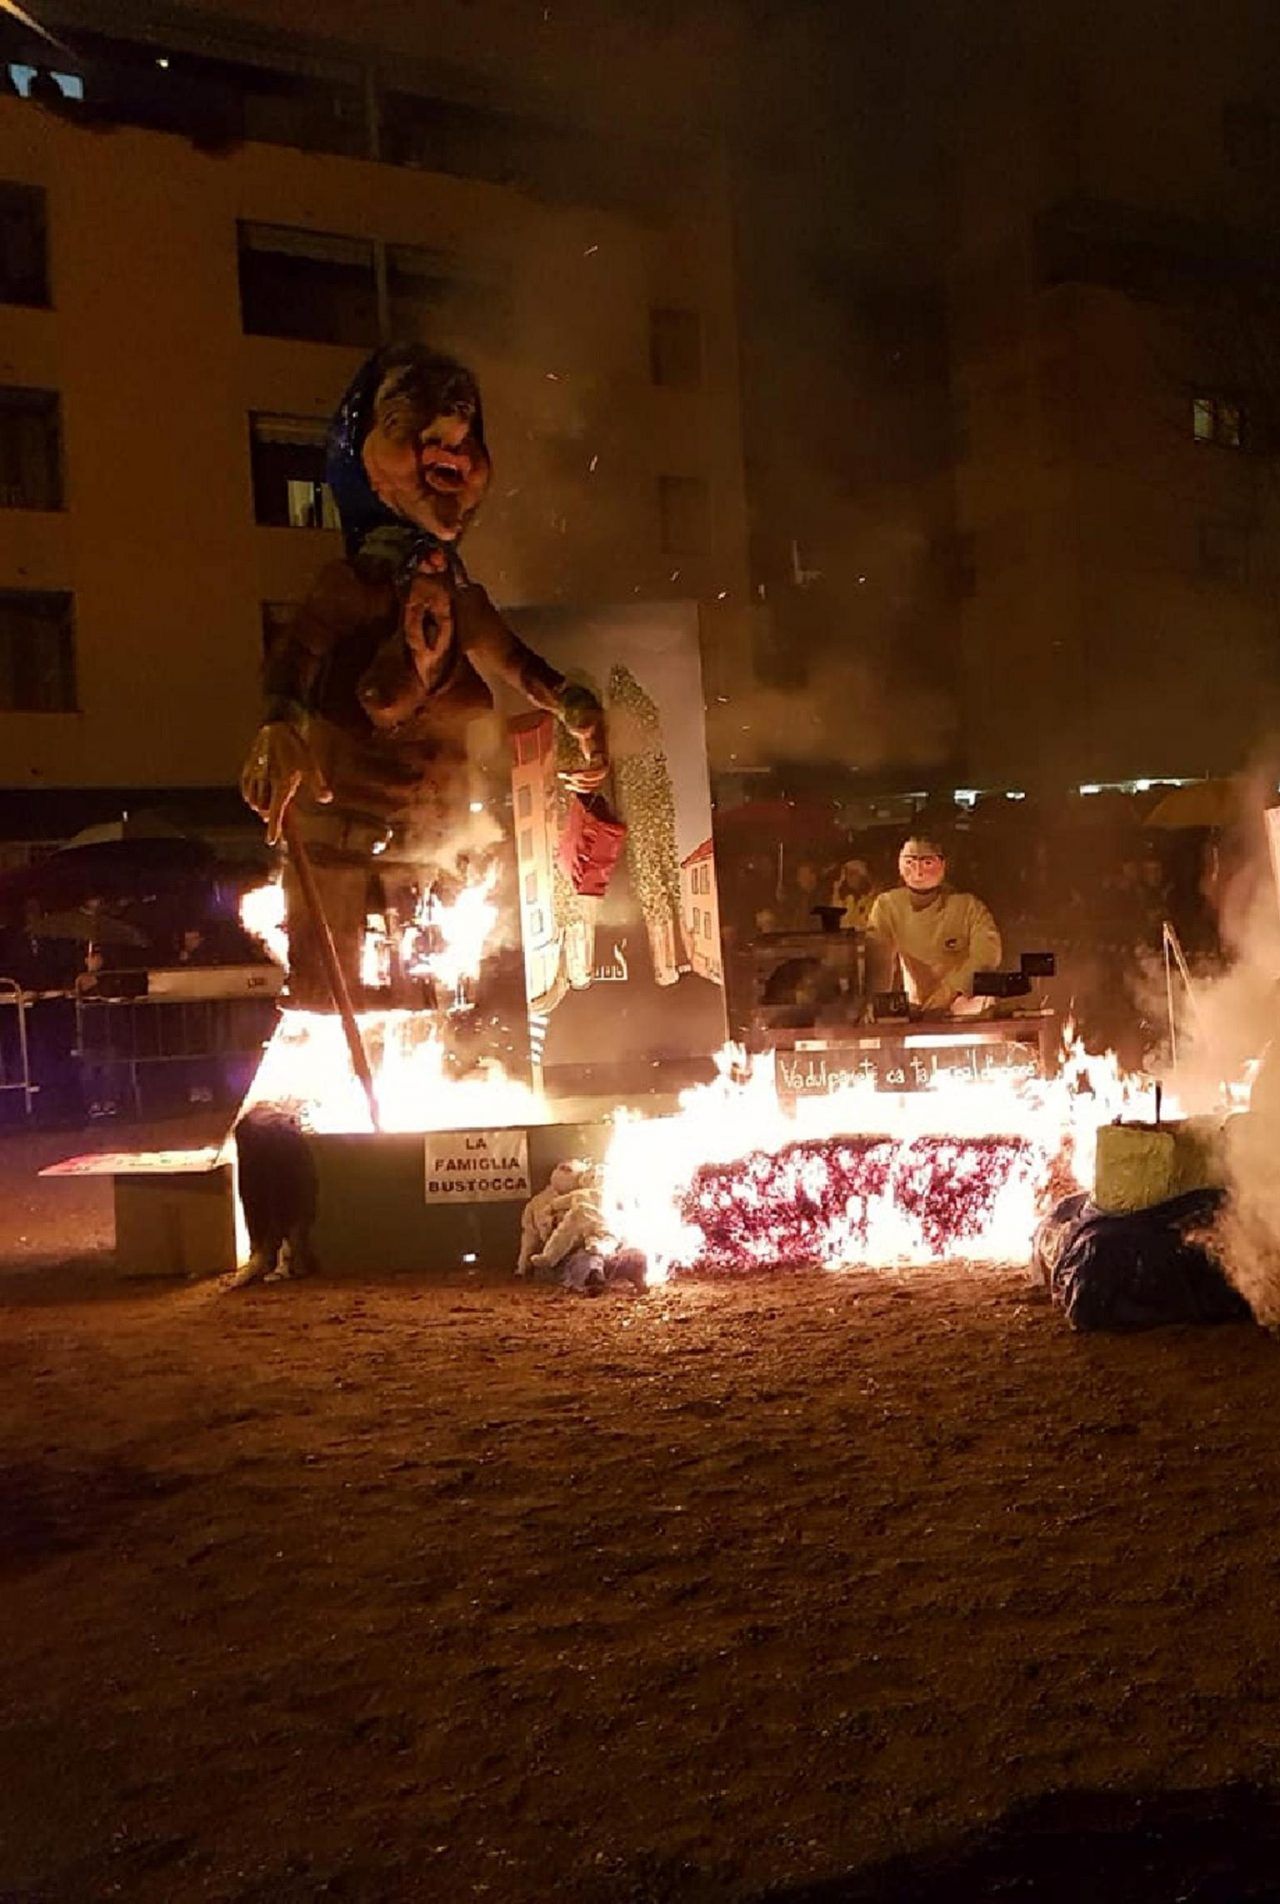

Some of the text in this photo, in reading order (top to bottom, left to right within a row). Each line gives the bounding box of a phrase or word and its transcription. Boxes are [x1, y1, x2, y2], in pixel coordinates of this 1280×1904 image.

[465, 1137, 487, 1150] LA
[434, 1157, 520, 1172] FAMIGLIA
[428, 1177, 527, 1192] BUSTOCCA
